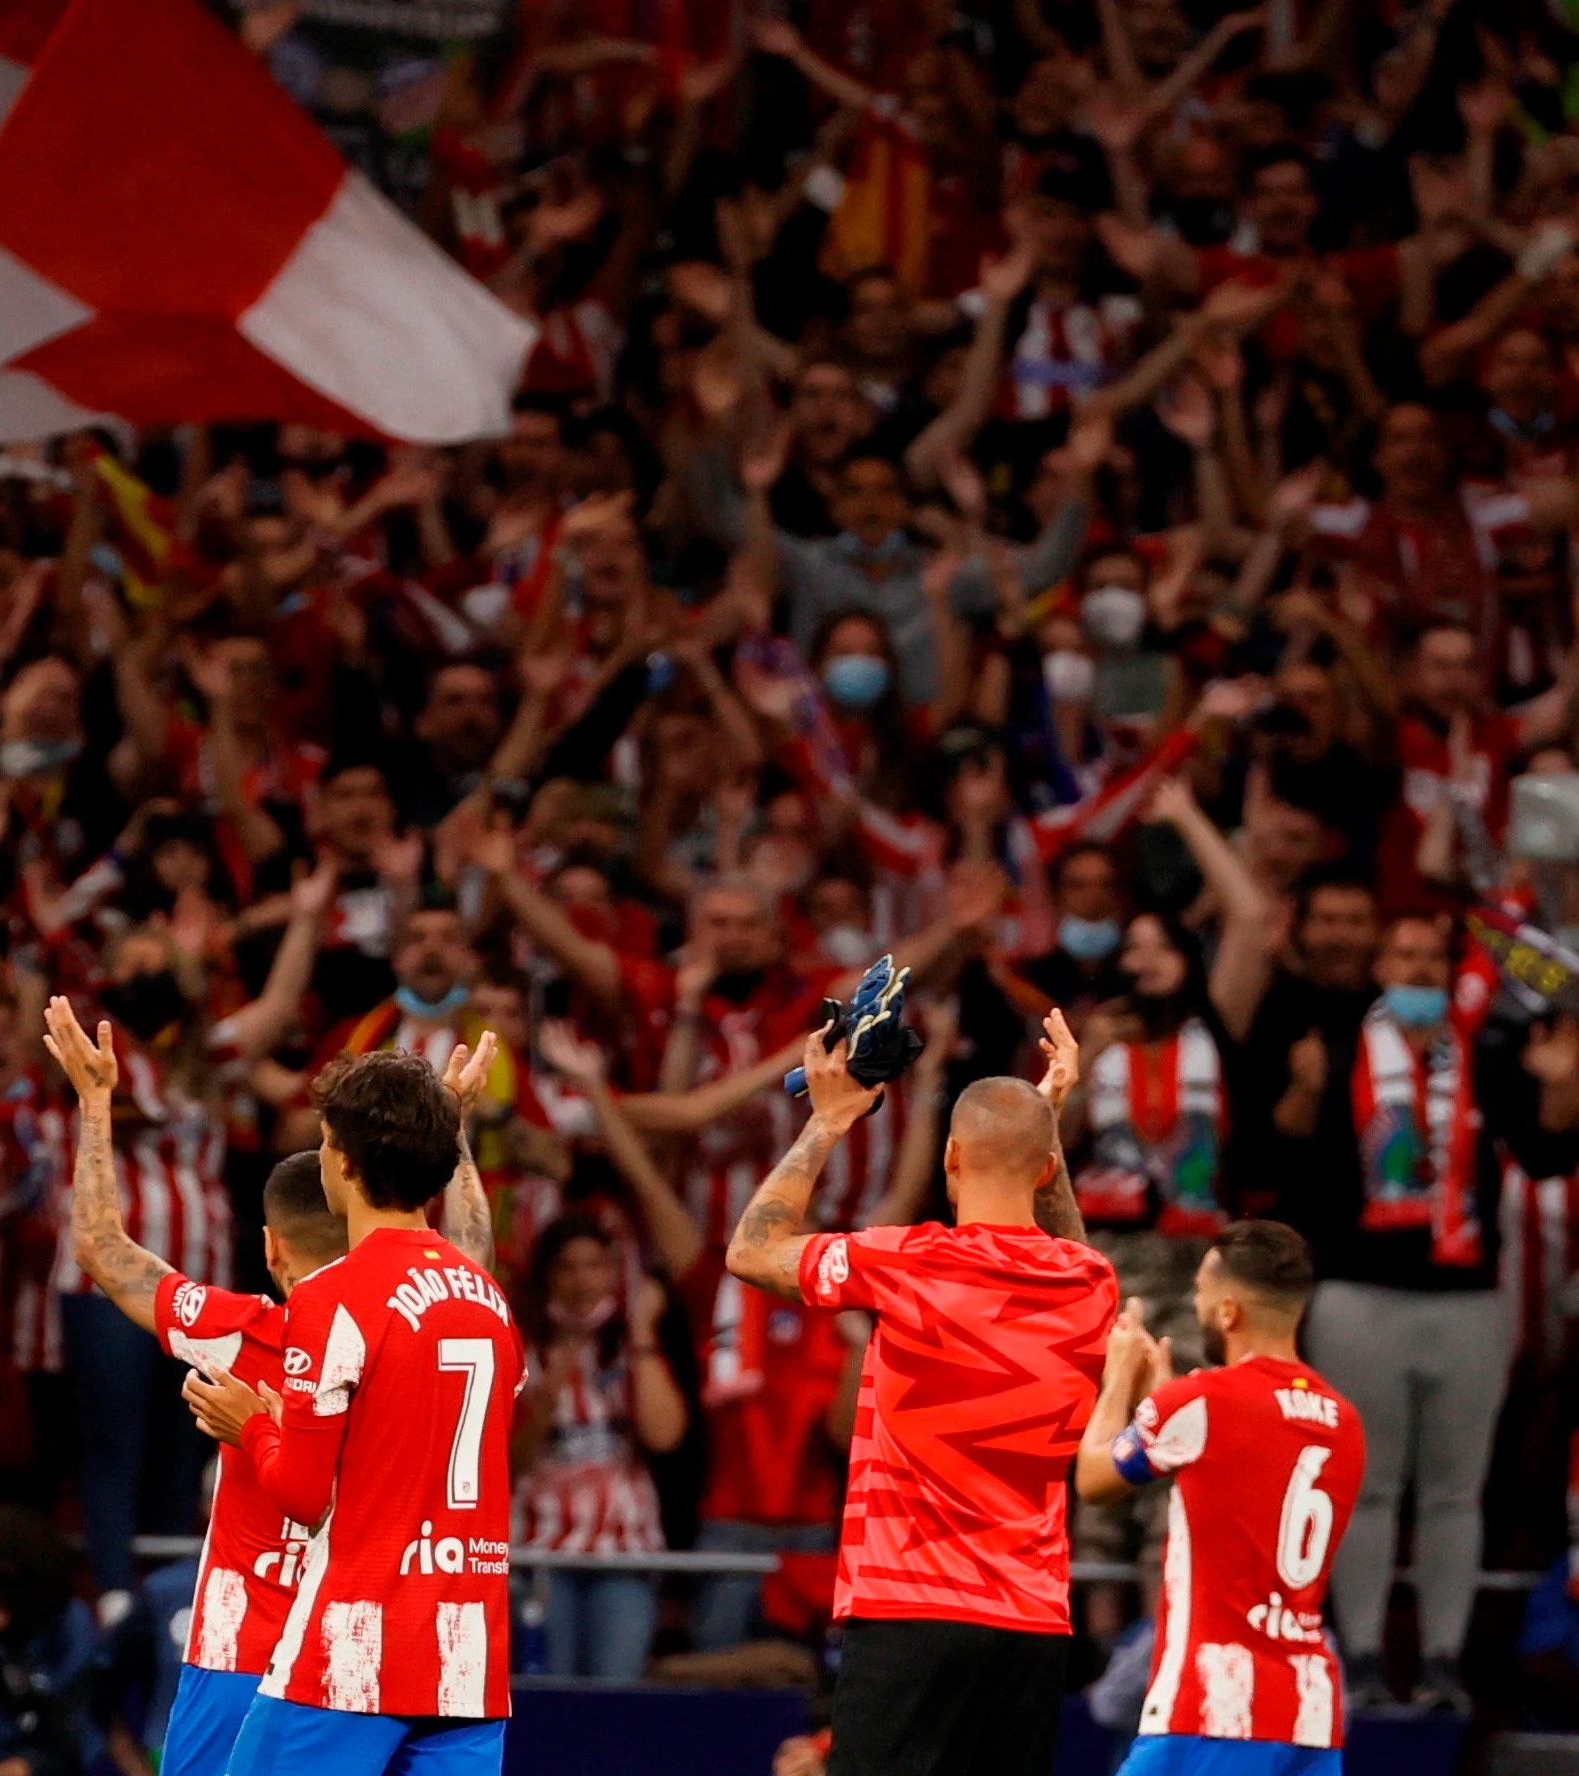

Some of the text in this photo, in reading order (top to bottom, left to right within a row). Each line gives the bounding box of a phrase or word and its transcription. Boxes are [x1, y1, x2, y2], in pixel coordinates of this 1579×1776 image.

[386, 1267, 449, 1333] JOÃO
[437, 1338, 495, 1510] 7
[1273, 1388, 1339, 1429] KOKE
[399, 1520, 464, 1575] ria
[1276, 1445, 1333, 1590] 6
[253, 1541, 306, 1588] ri
